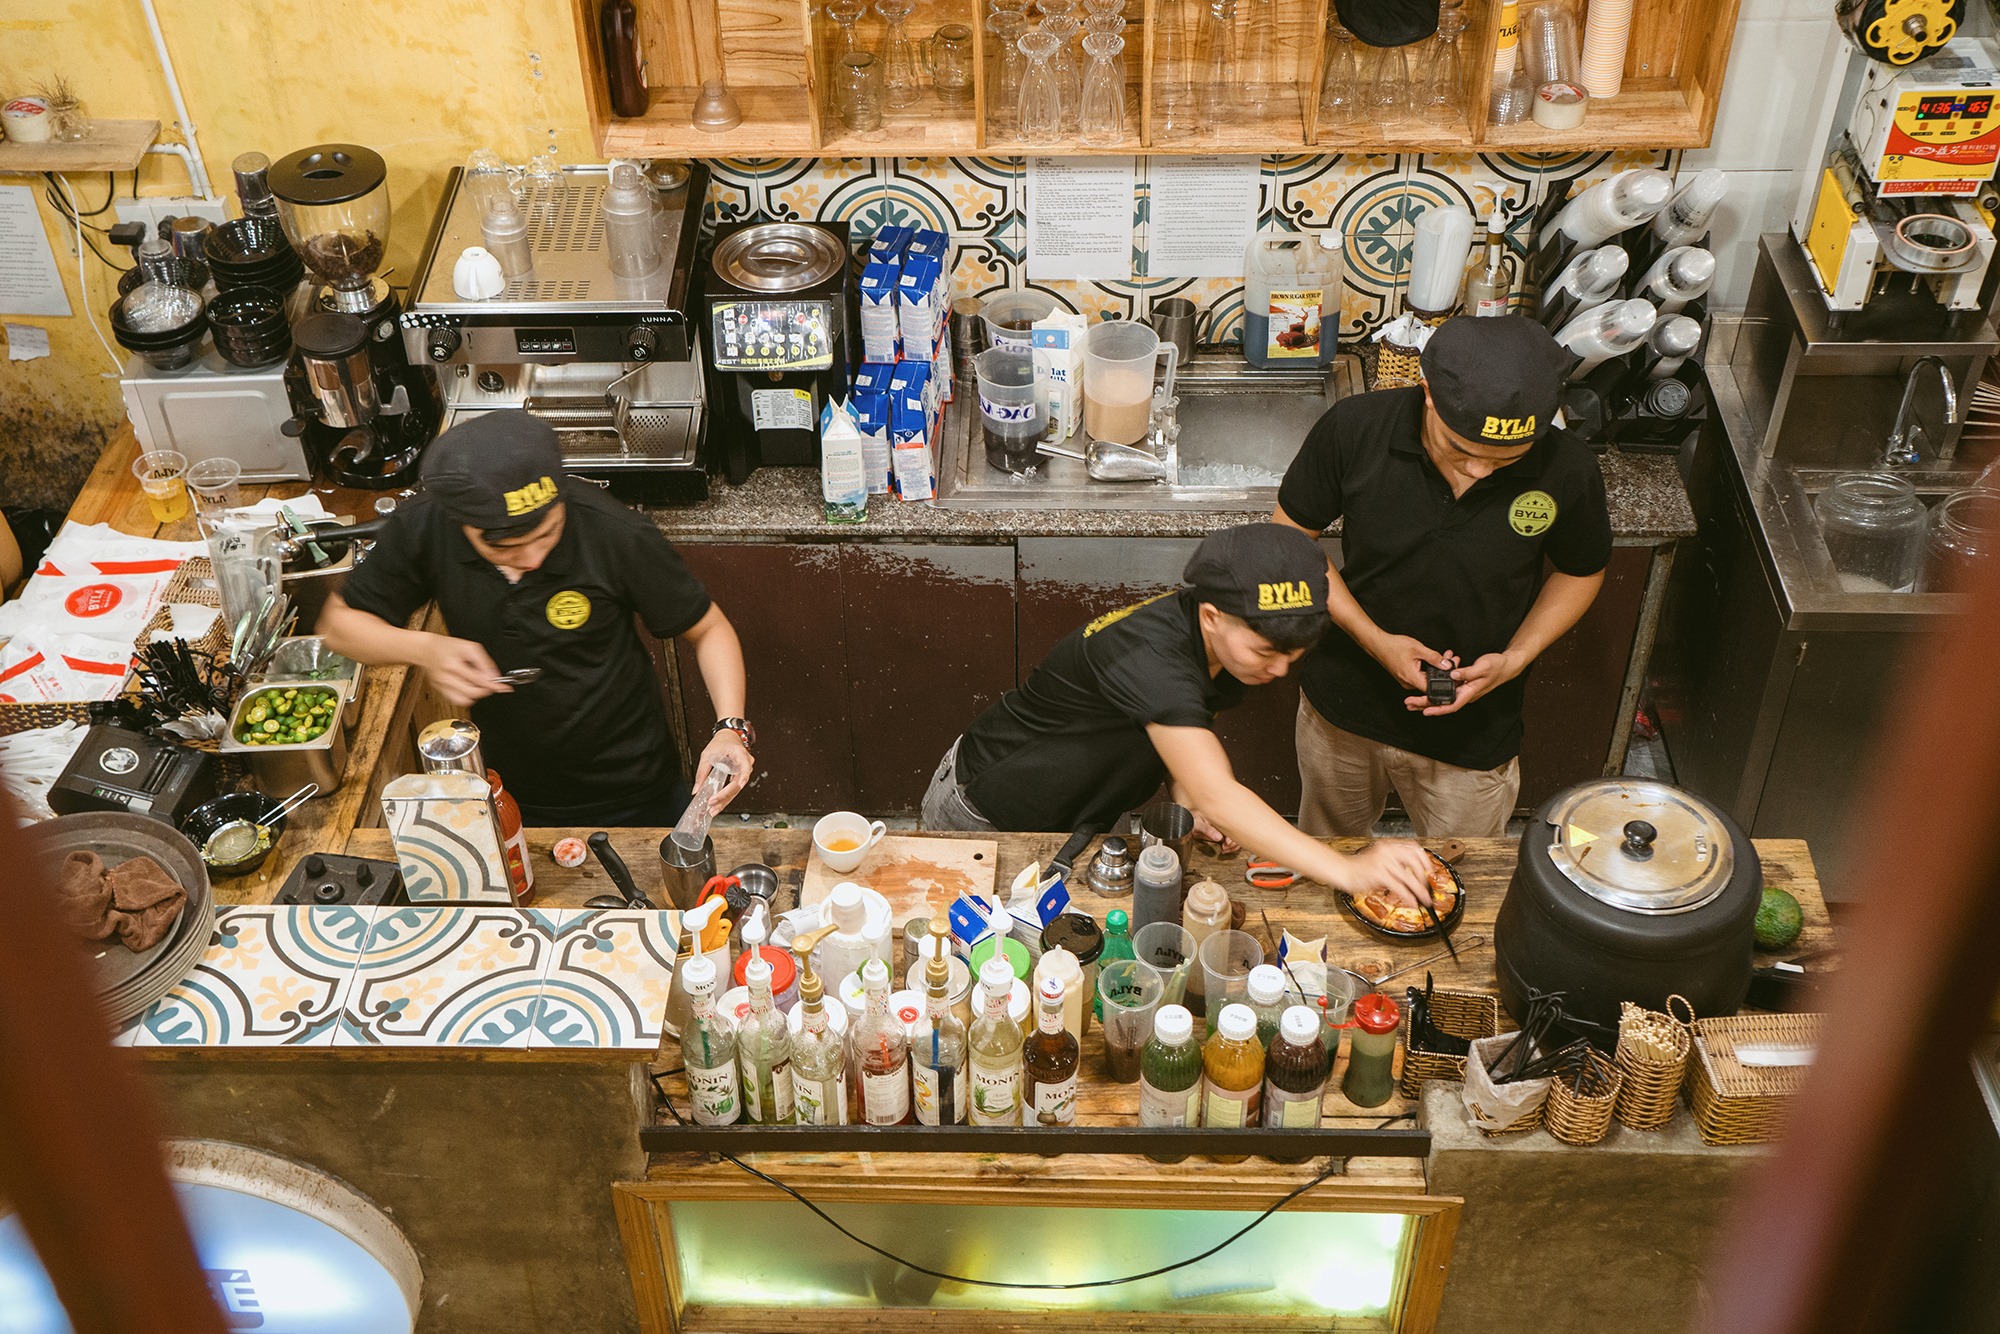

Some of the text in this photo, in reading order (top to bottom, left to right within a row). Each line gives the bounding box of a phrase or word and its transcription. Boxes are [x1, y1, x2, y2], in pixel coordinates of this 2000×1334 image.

[1500, 25, 1517, 37] BYL
[1482, 415, 1536, 435] BYLA
[1514, 510, 1548, 520] BYLA
[1258, 581, 1312, 604] BYLA
[1045, 1086, 1075, 1101] MON
